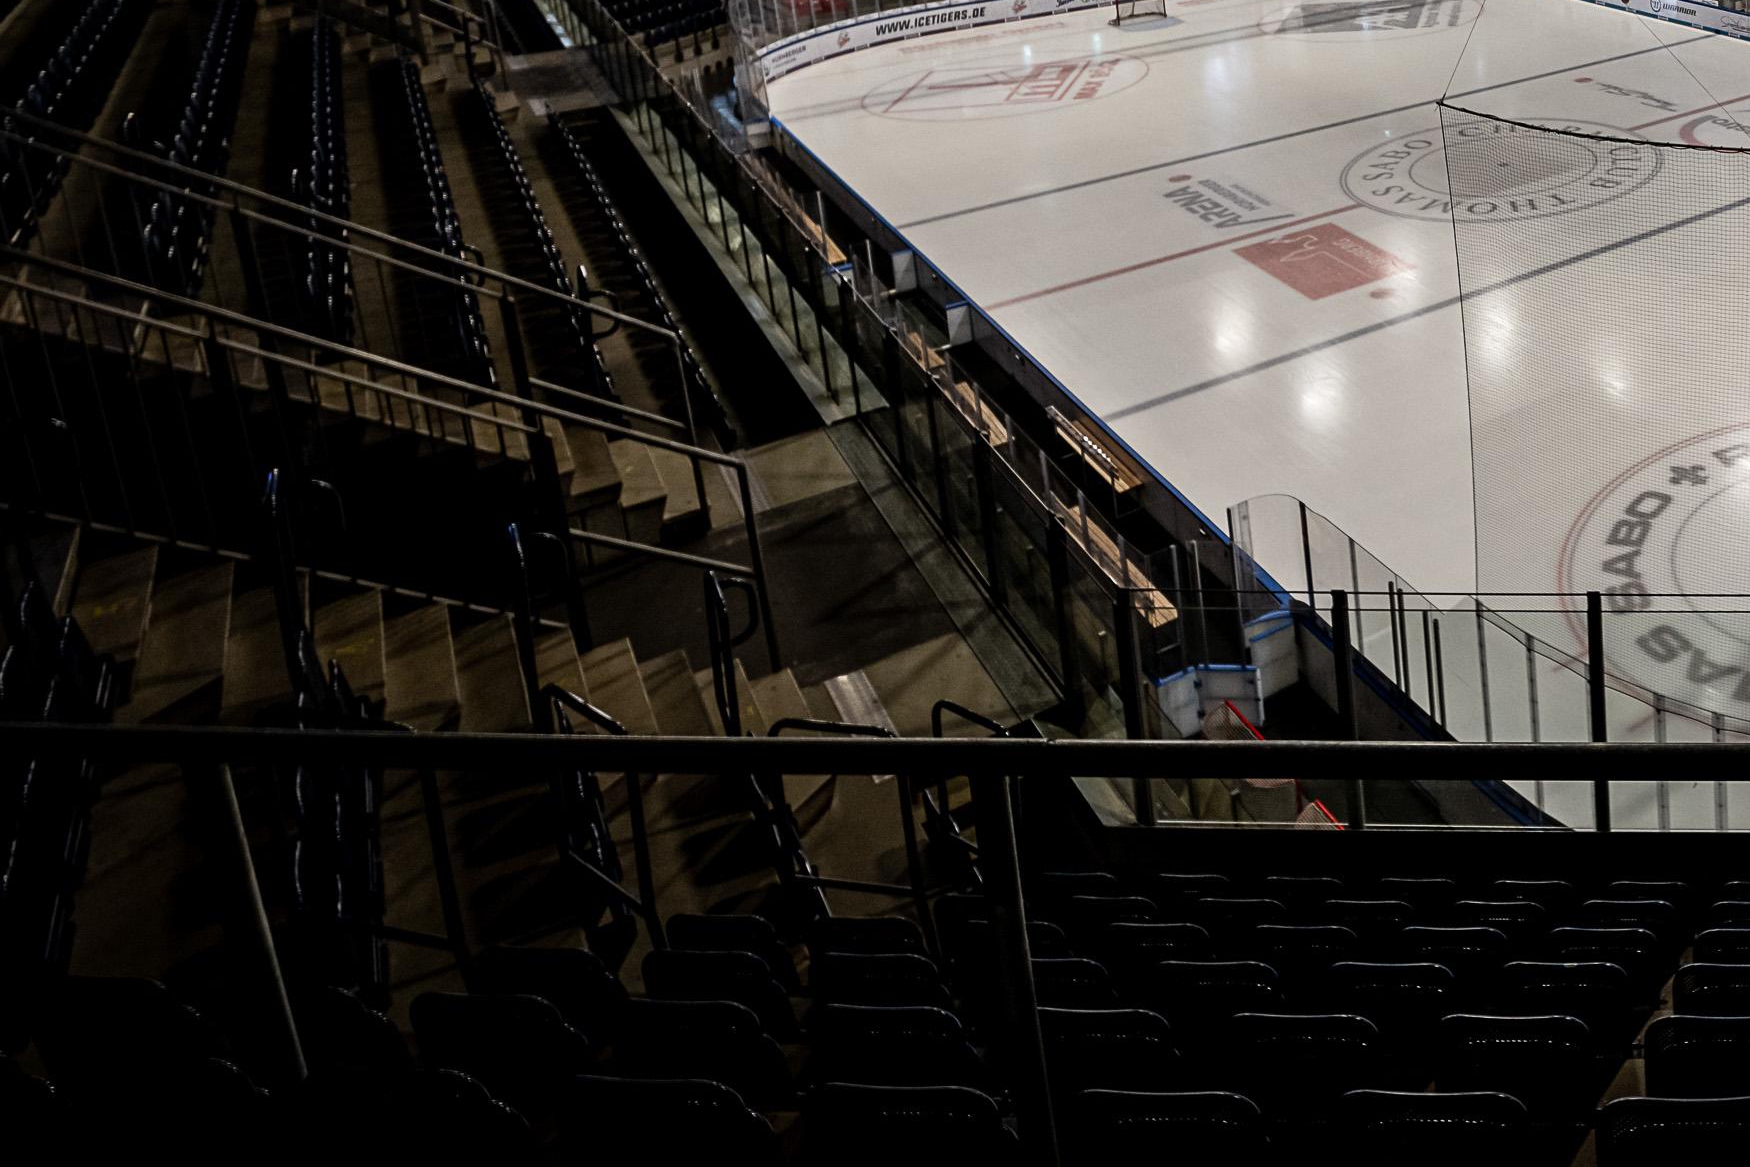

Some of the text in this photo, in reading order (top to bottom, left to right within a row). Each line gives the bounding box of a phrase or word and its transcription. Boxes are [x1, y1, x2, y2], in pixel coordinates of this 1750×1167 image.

[875, 6, 987, 36] WWW.ICETIGERS.DE
[1362, 138, 1433, 182] SABO
[1163, 185, 1243, 228] ARENA
[1602, 489, 1673, 616] SABO
